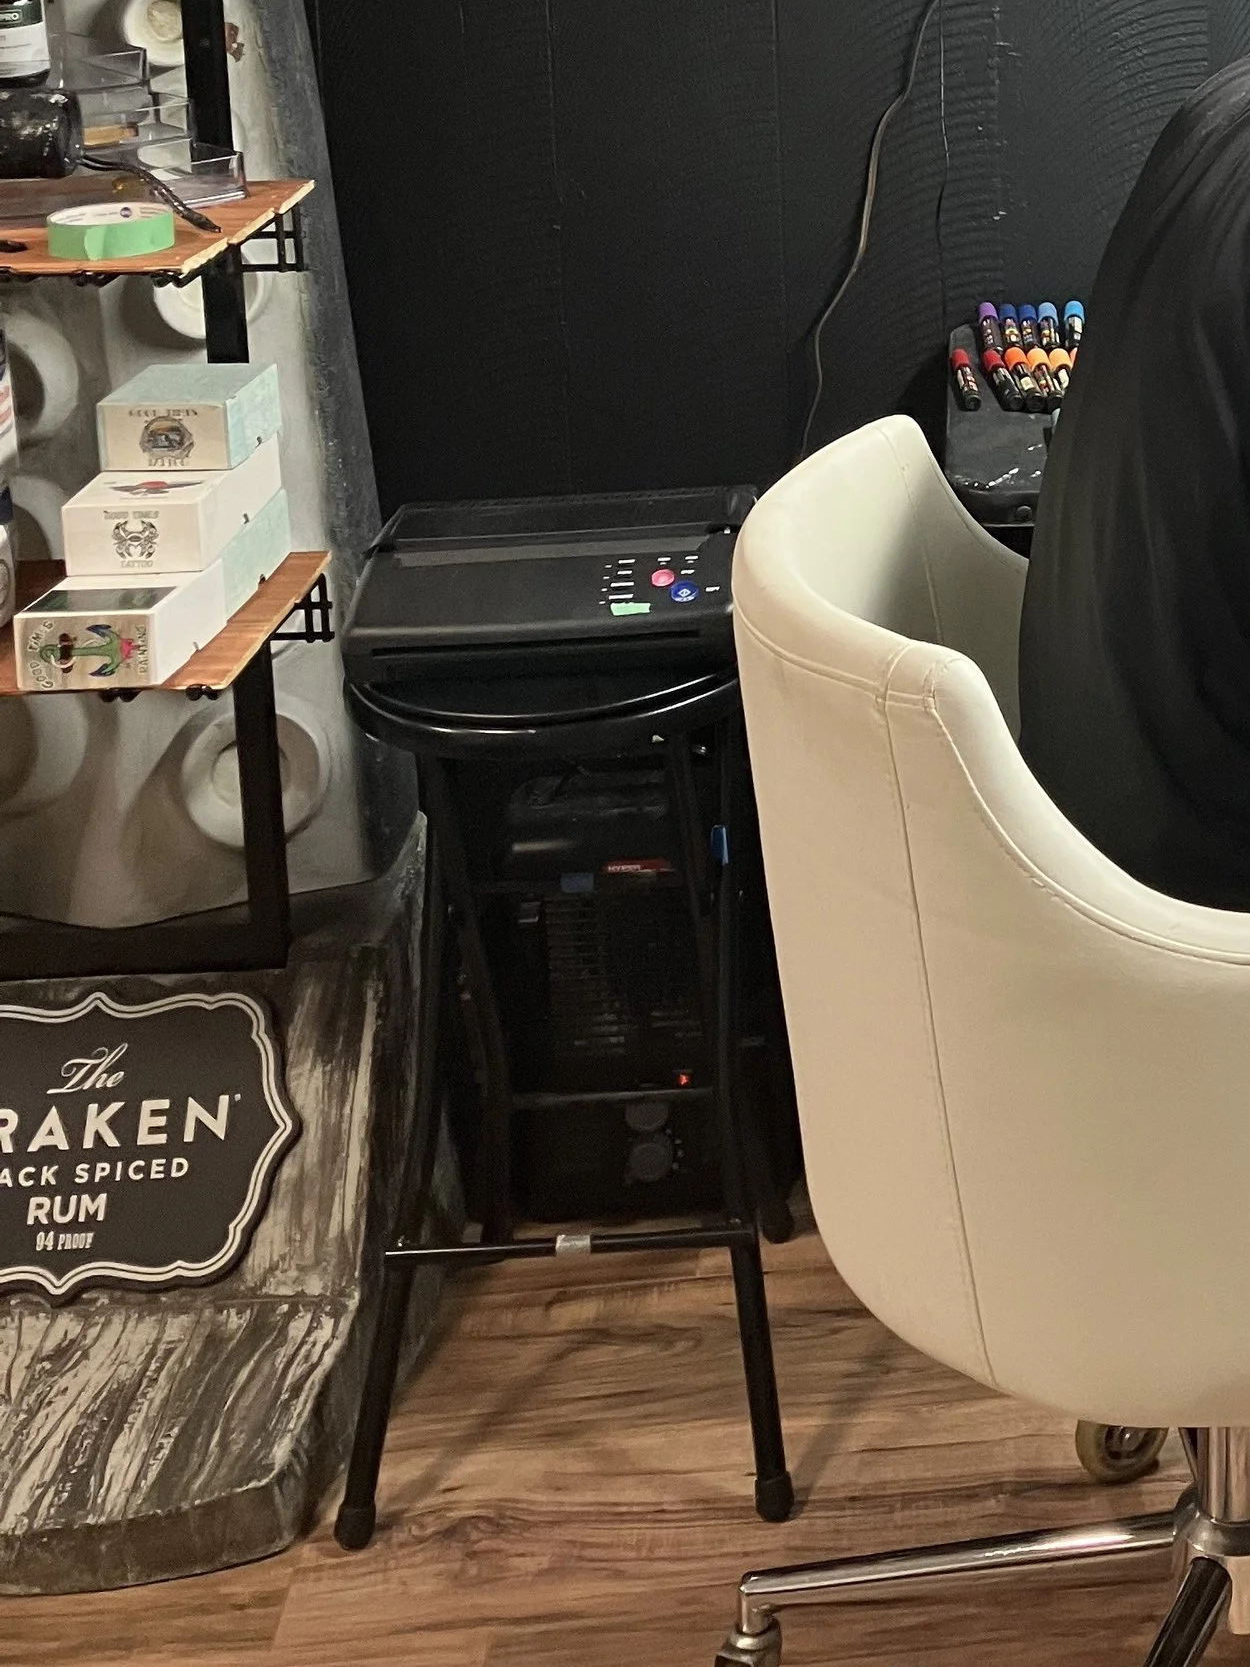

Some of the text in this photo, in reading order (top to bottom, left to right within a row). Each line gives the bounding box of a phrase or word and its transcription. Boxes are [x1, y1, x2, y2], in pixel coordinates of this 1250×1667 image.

[29, 661, 54, 689] GOOD
[46, 1042, 128, 1095] The
[74, 1157, 190, 1184] SPICED
[26, 1192, 107, 1225] RUM
